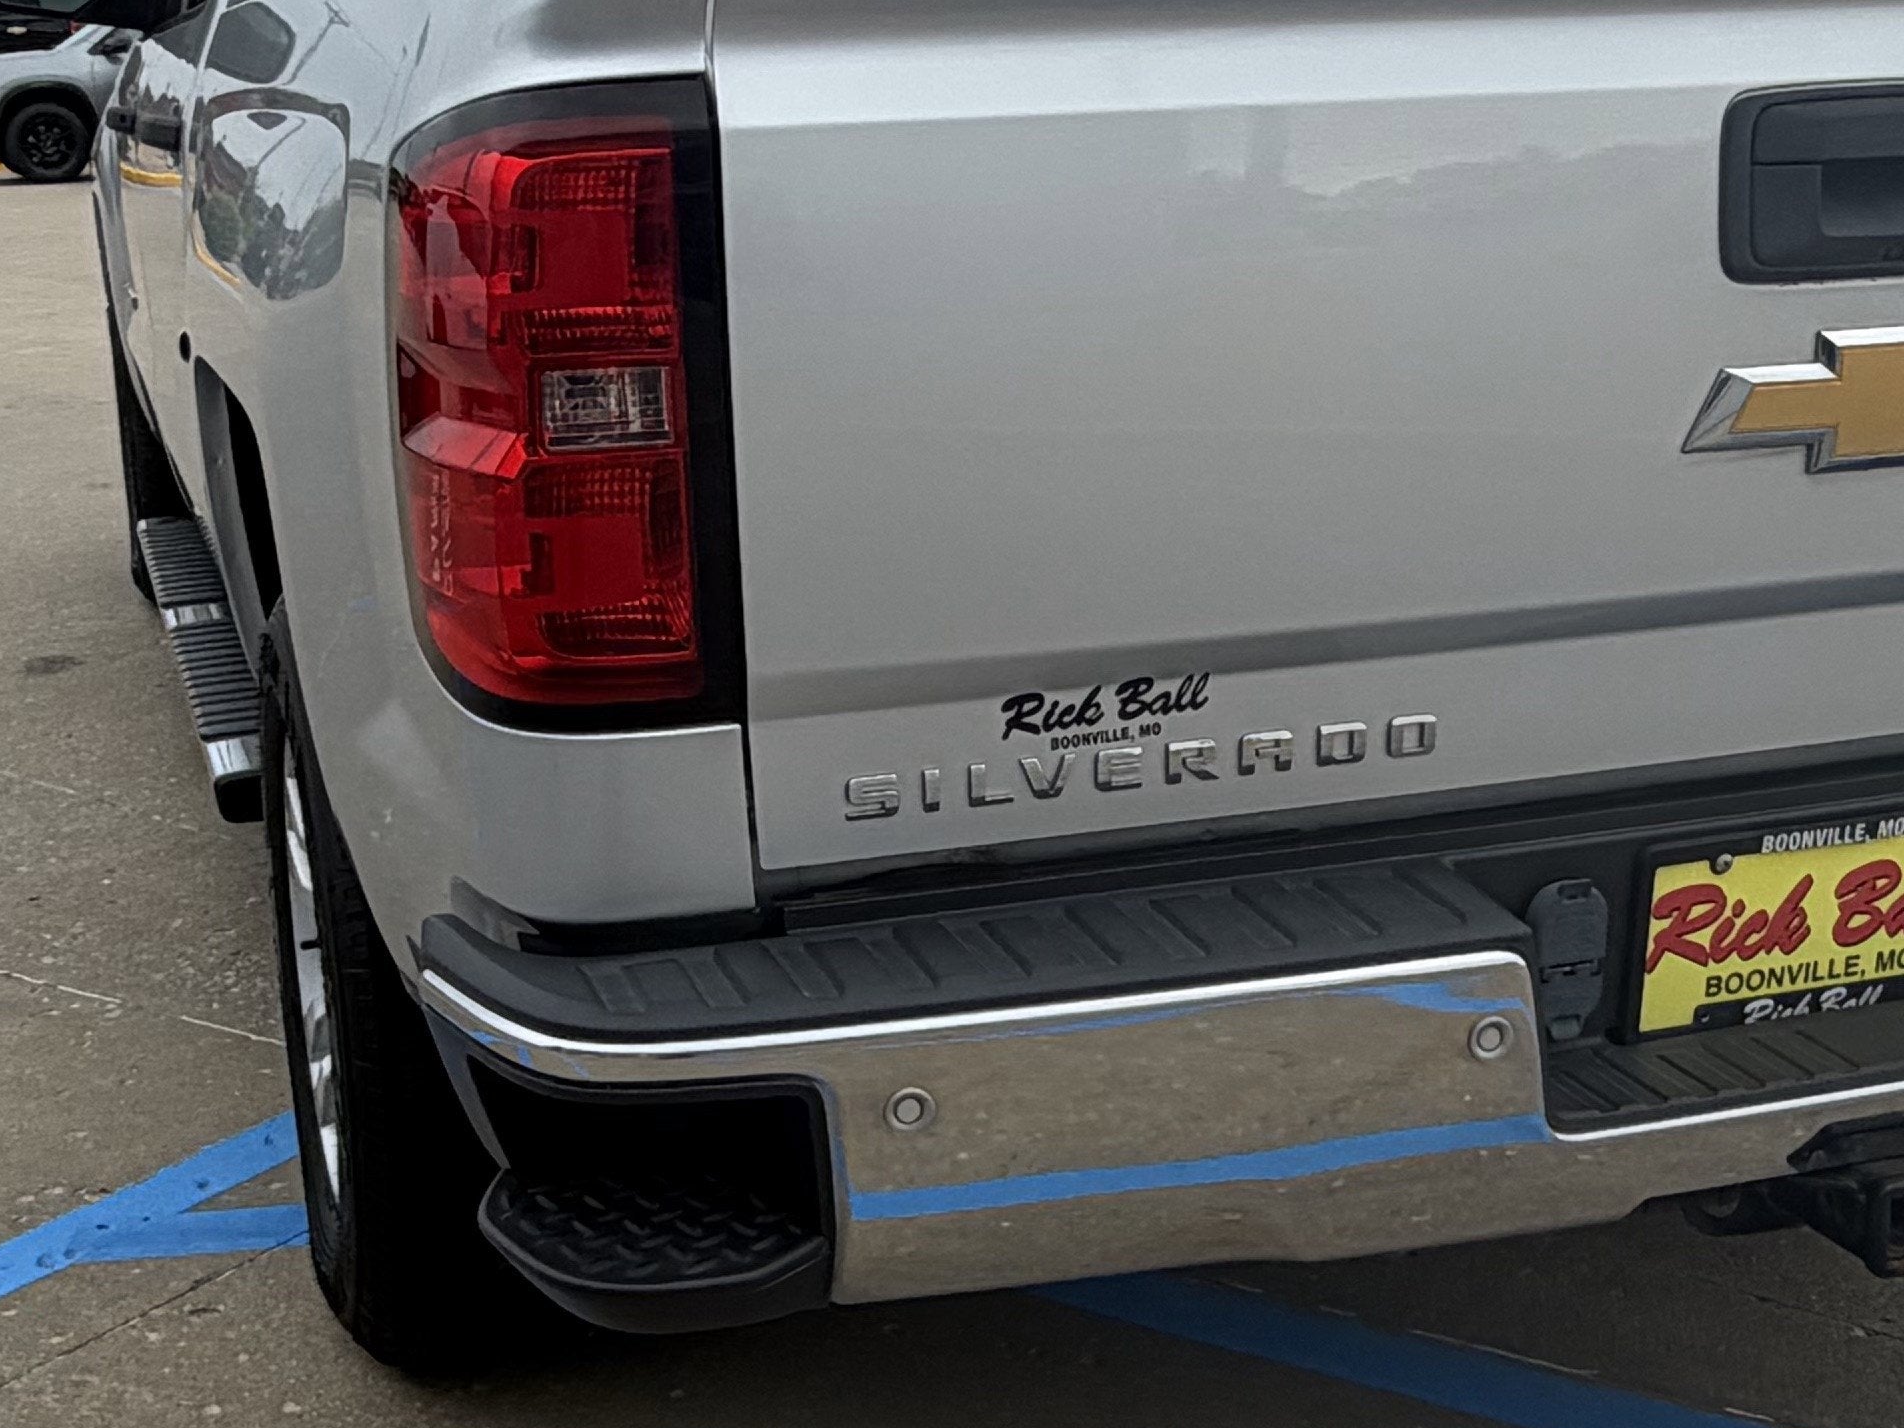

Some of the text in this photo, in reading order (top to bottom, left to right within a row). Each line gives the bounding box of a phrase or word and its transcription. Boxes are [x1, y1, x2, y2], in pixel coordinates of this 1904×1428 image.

[1000, 672, 1212, 741] Rick Ball
[1050, 722, 1162, 752] BOONVILLE, MO
[844, 713, 1438, 822] SILVERADO
[1761, 822, 1870, 854] BOONVILLE,
[1646, 873, 1814, 973] Rick
[1704, 955, 1866, 998] BOONVILLE,
